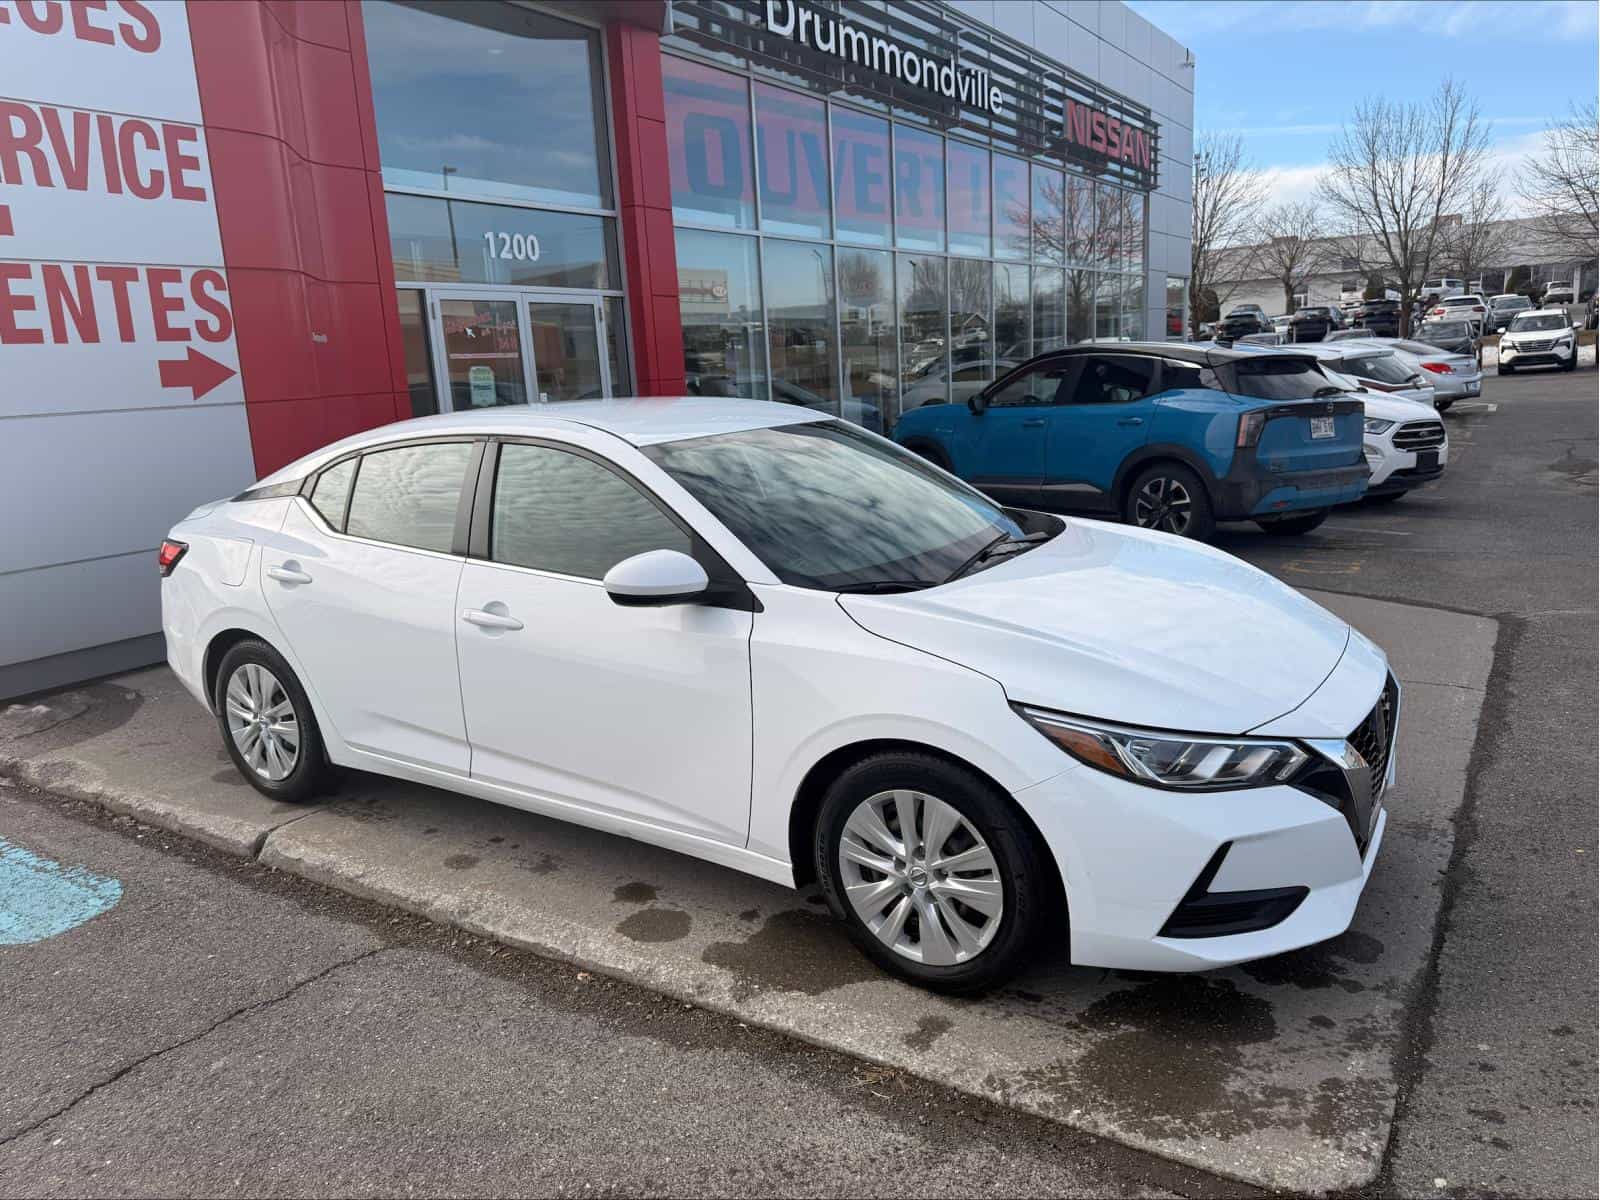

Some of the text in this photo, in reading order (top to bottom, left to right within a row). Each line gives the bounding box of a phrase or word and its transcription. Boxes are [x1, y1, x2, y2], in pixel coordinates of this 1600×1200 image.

[766, 0, 1003, 114] Drummondville
[683, 110, 948, 219] OUVERT
[1065, 99, 1150, 169] NISSAN
[484, 231, 540, 261] 1200
[0, 262, 233, 343] ENTES
